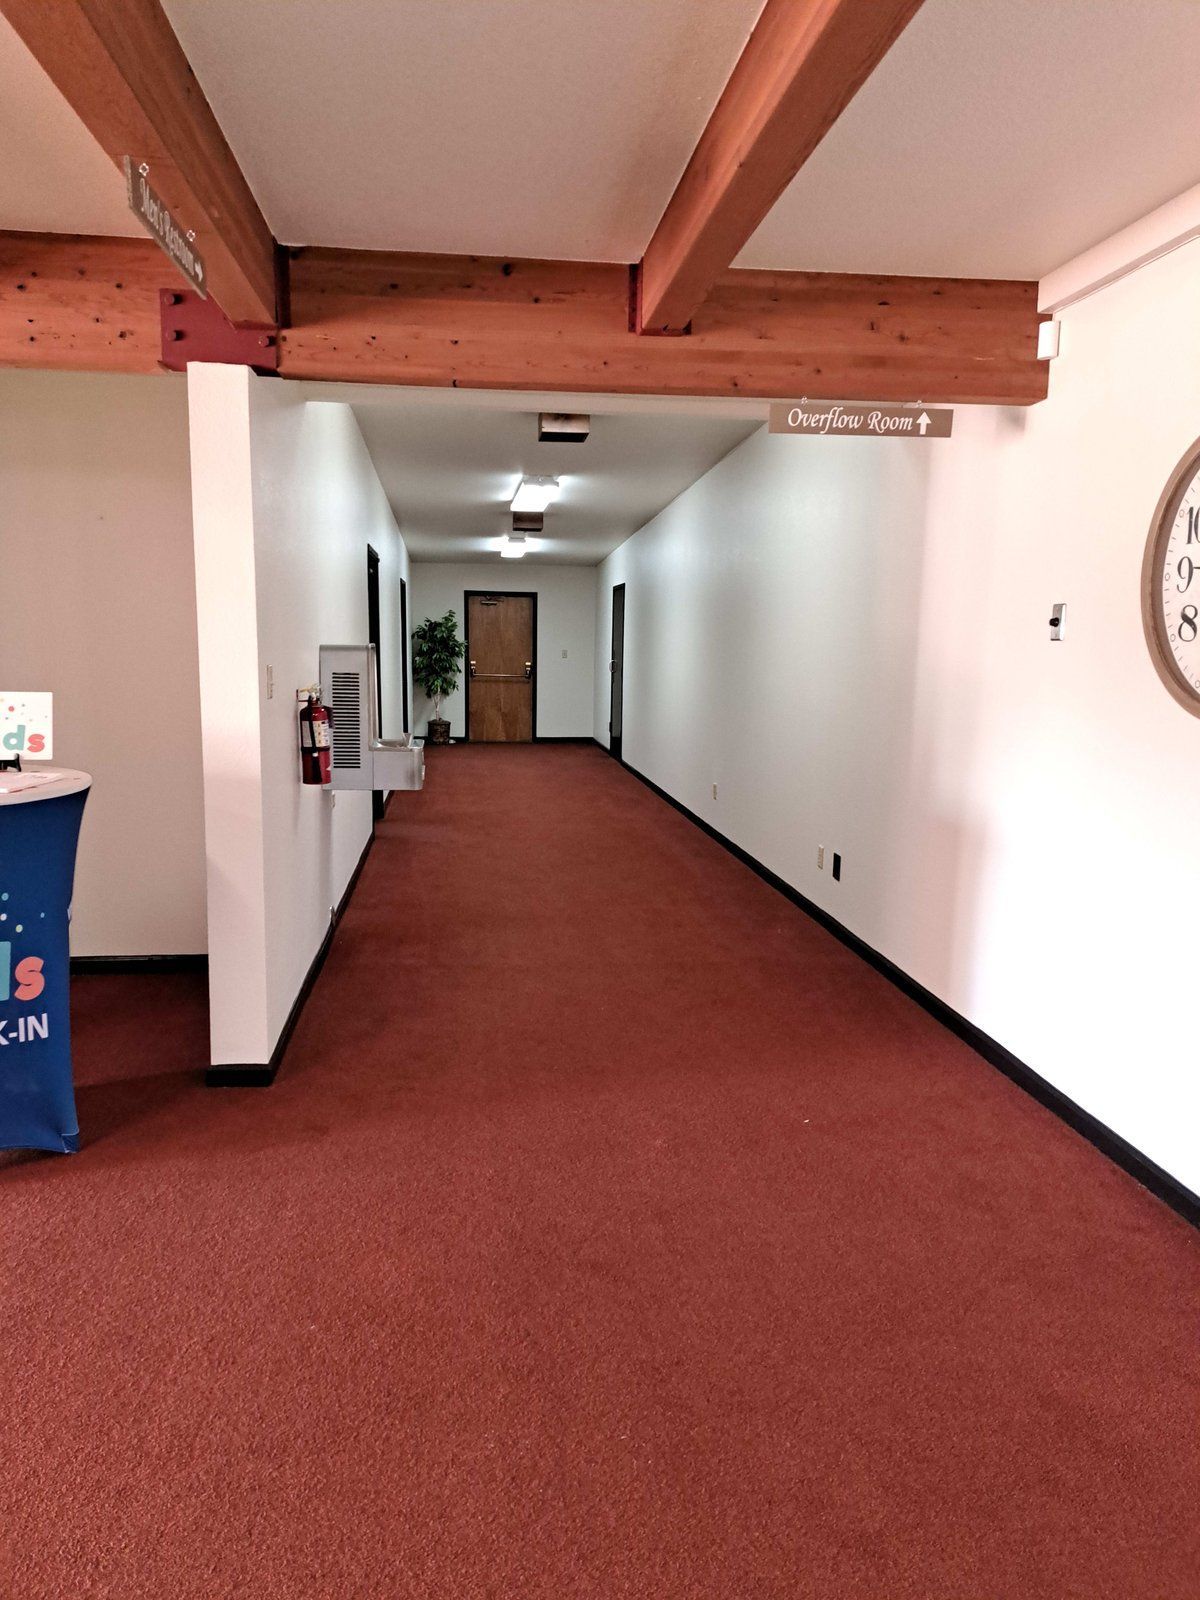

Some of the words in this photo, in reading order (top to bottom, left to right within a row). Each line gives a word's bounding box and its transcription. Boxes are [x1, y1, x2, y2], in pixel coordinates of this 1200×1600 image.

[787, 406, 864, 434] Overflow
[867, 411, 913, 434] Room
[1176, 555, 1194, 594] 9
[1178, 604, 1198, 642] 8
[0, 941, 46, 1002] s
